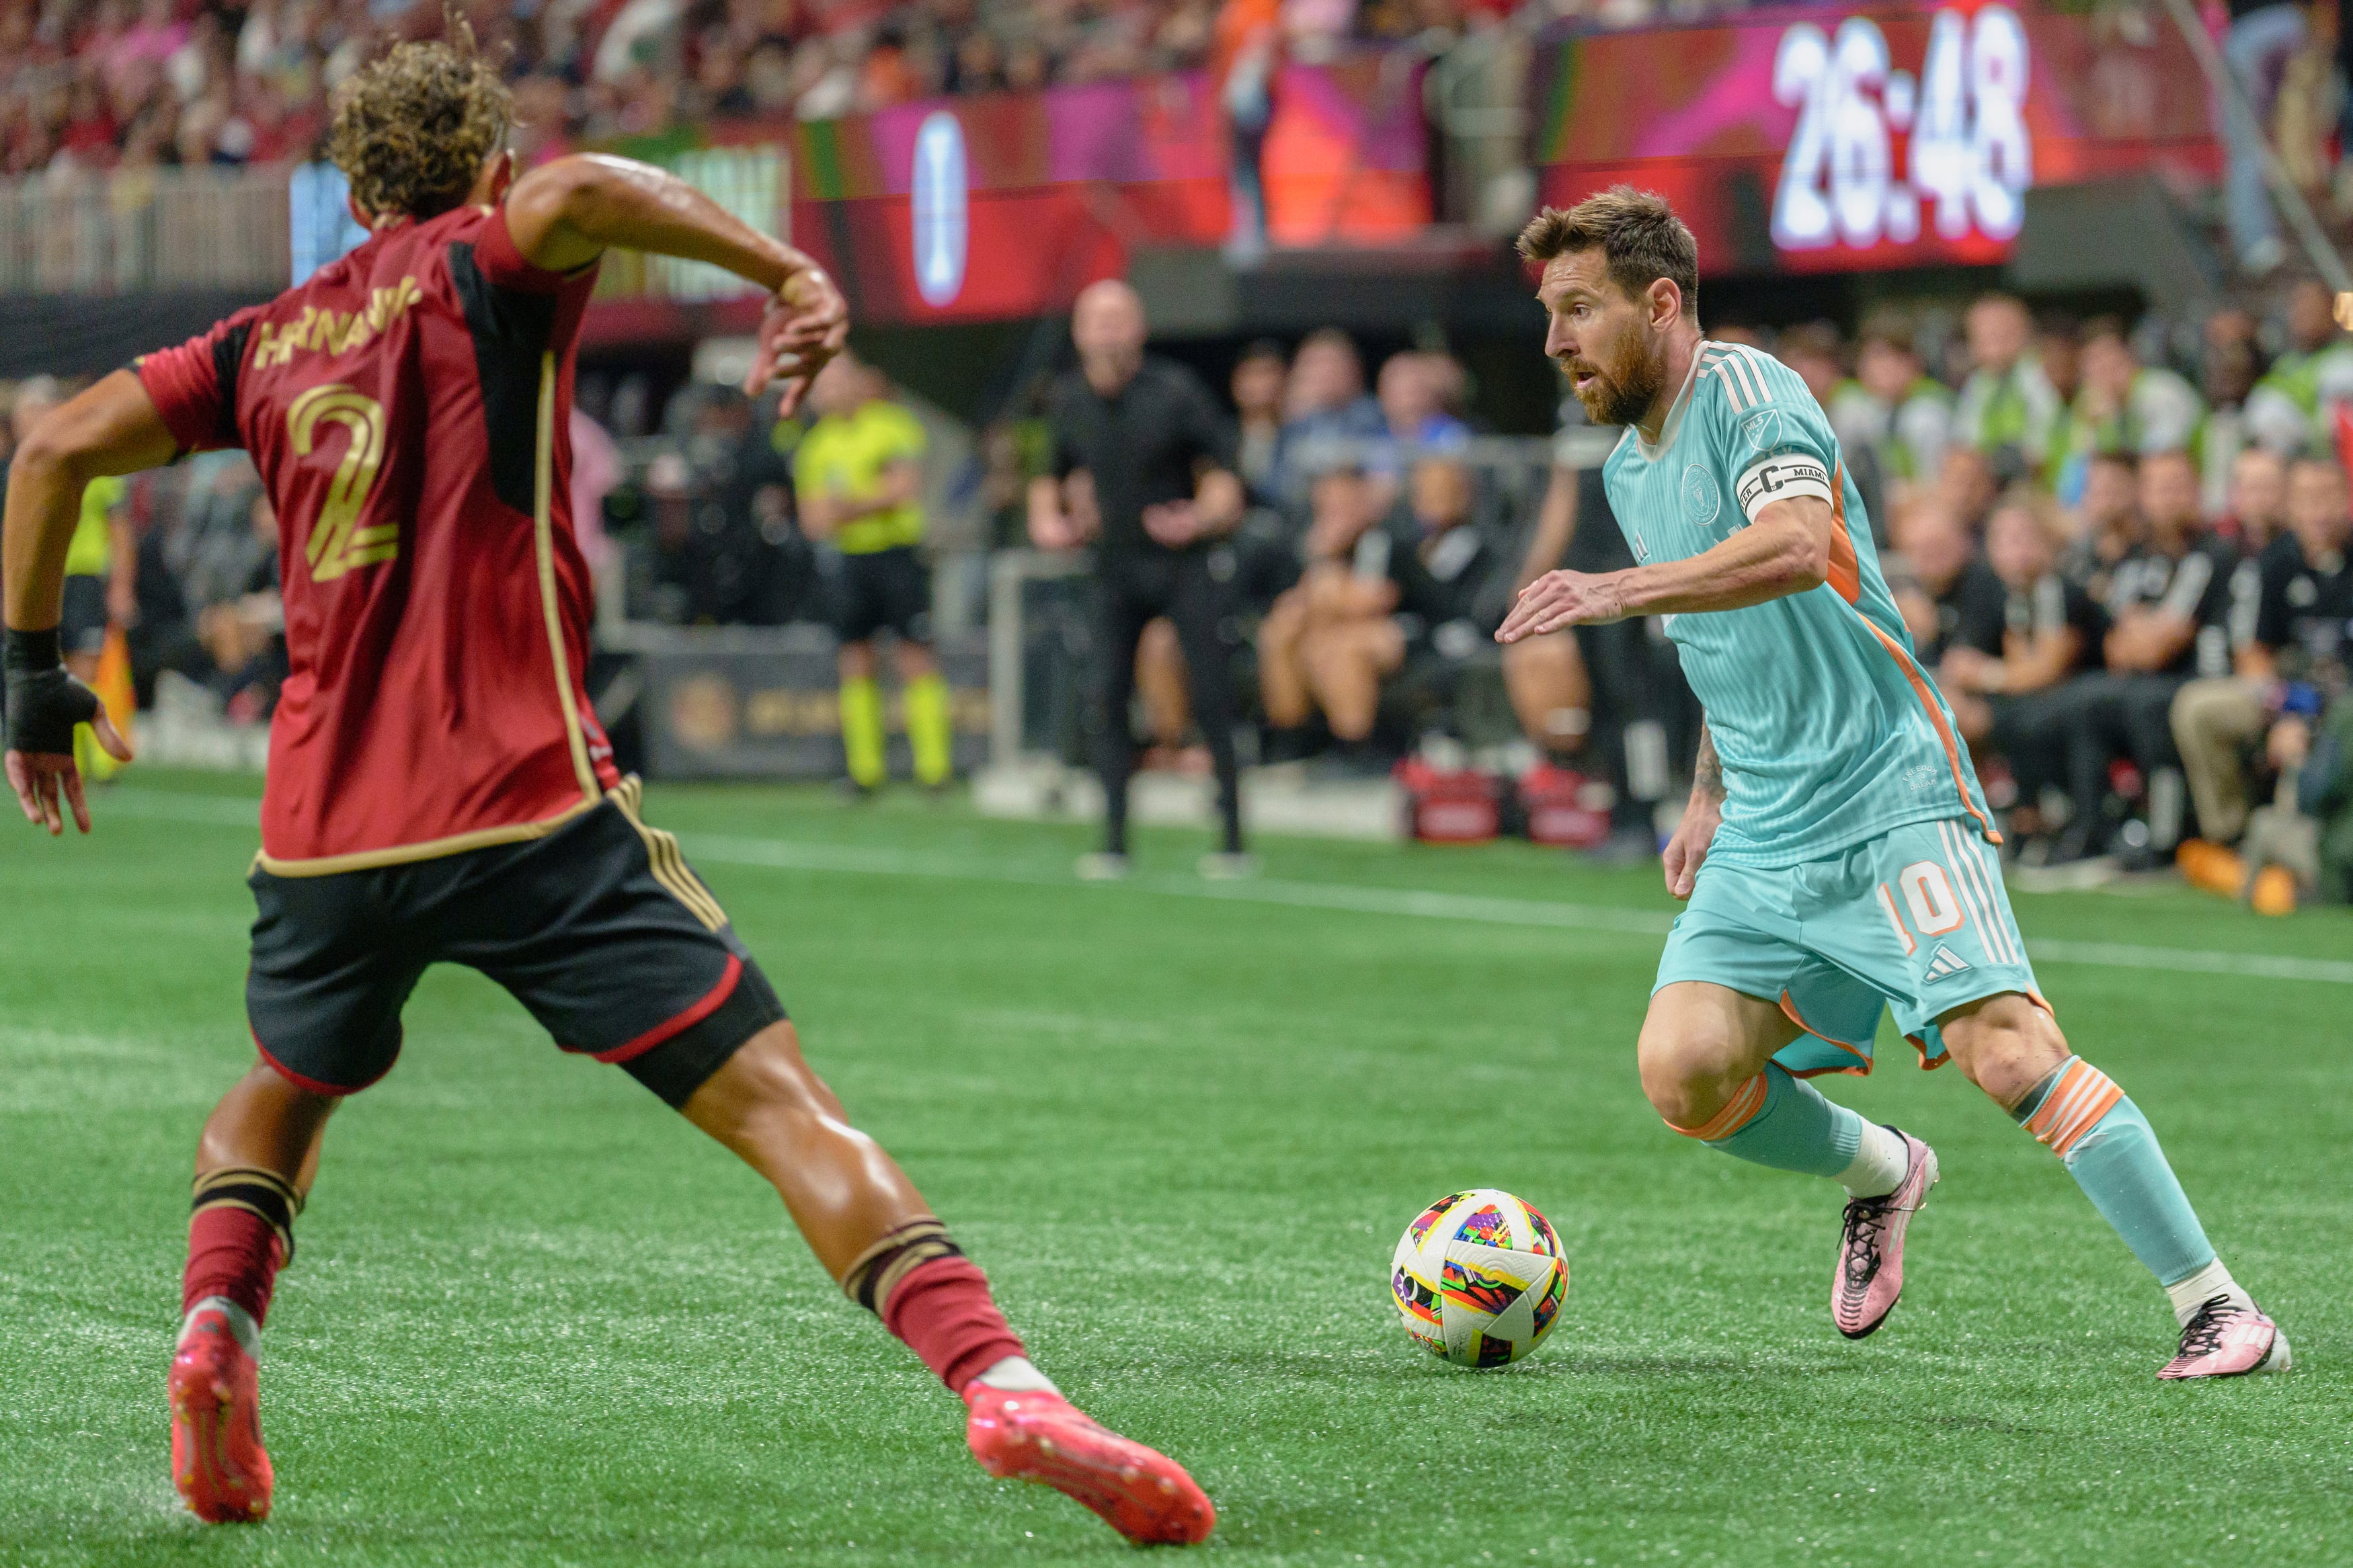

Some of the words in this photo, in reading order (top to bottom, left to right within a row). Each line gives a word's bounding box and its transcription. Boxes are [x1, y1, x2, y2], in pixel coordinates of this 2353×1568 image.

[1771, 5, 2033, 249] 26:48
[1745, 416, 1764, 432] MLS
[287, 383, 399, 583] 2
[1759, 465, 1784, 493] C
[1794, 468, 1825, 481] MIAMI
[1903, 765, 1938, 782] FREEDOM
[1910, 778, 1936, 791] DREAM
[1877, 860, 1966, 957] 10
